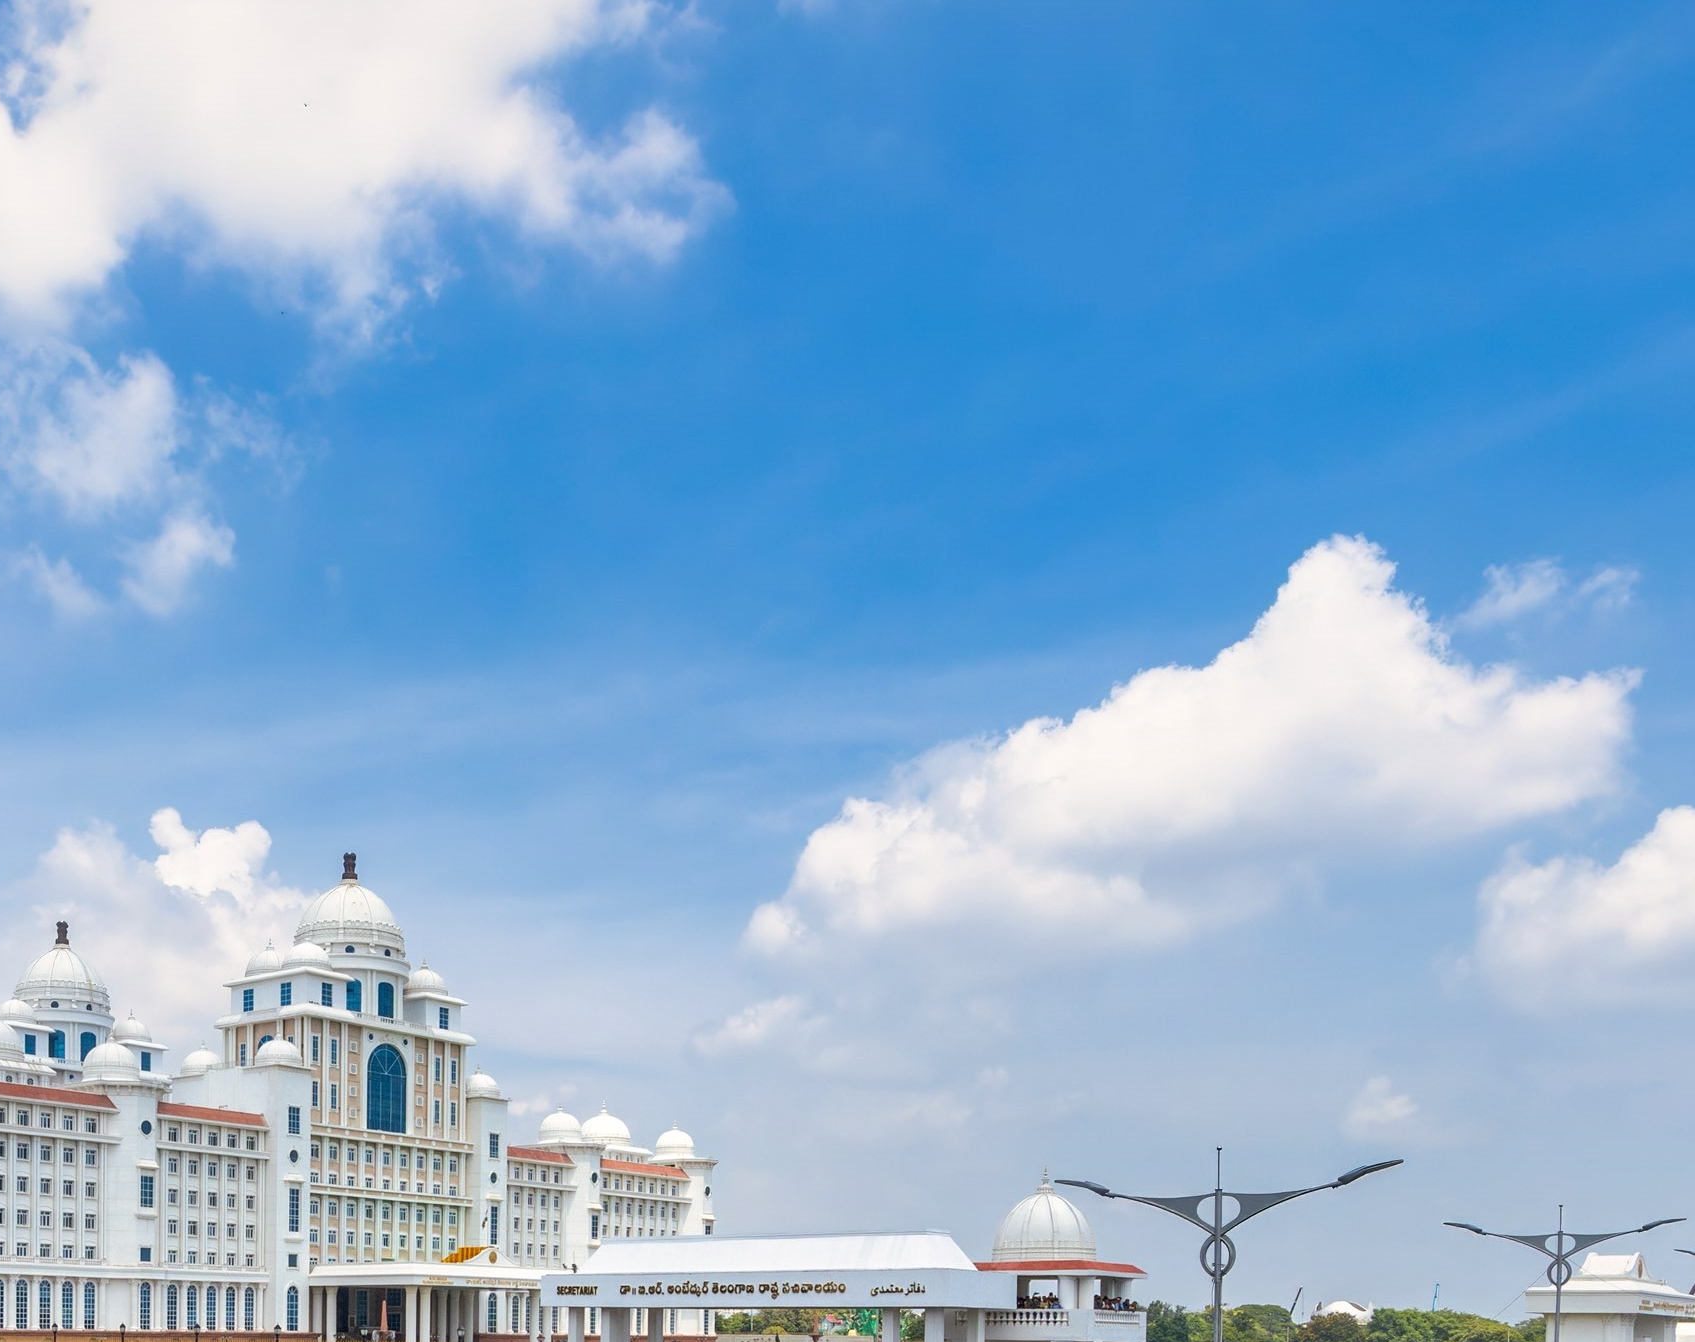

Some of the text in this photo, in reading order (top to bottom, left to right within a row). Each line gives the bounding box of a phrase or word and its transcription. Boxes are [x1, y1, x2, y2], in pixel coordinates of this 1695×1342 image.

[556, 1286, 599, 1296] SECRETARIAT
[711, 1282, 755, 1296] తెలంగాణ
[782, 1281, 847, 1295] సచివాలయం
